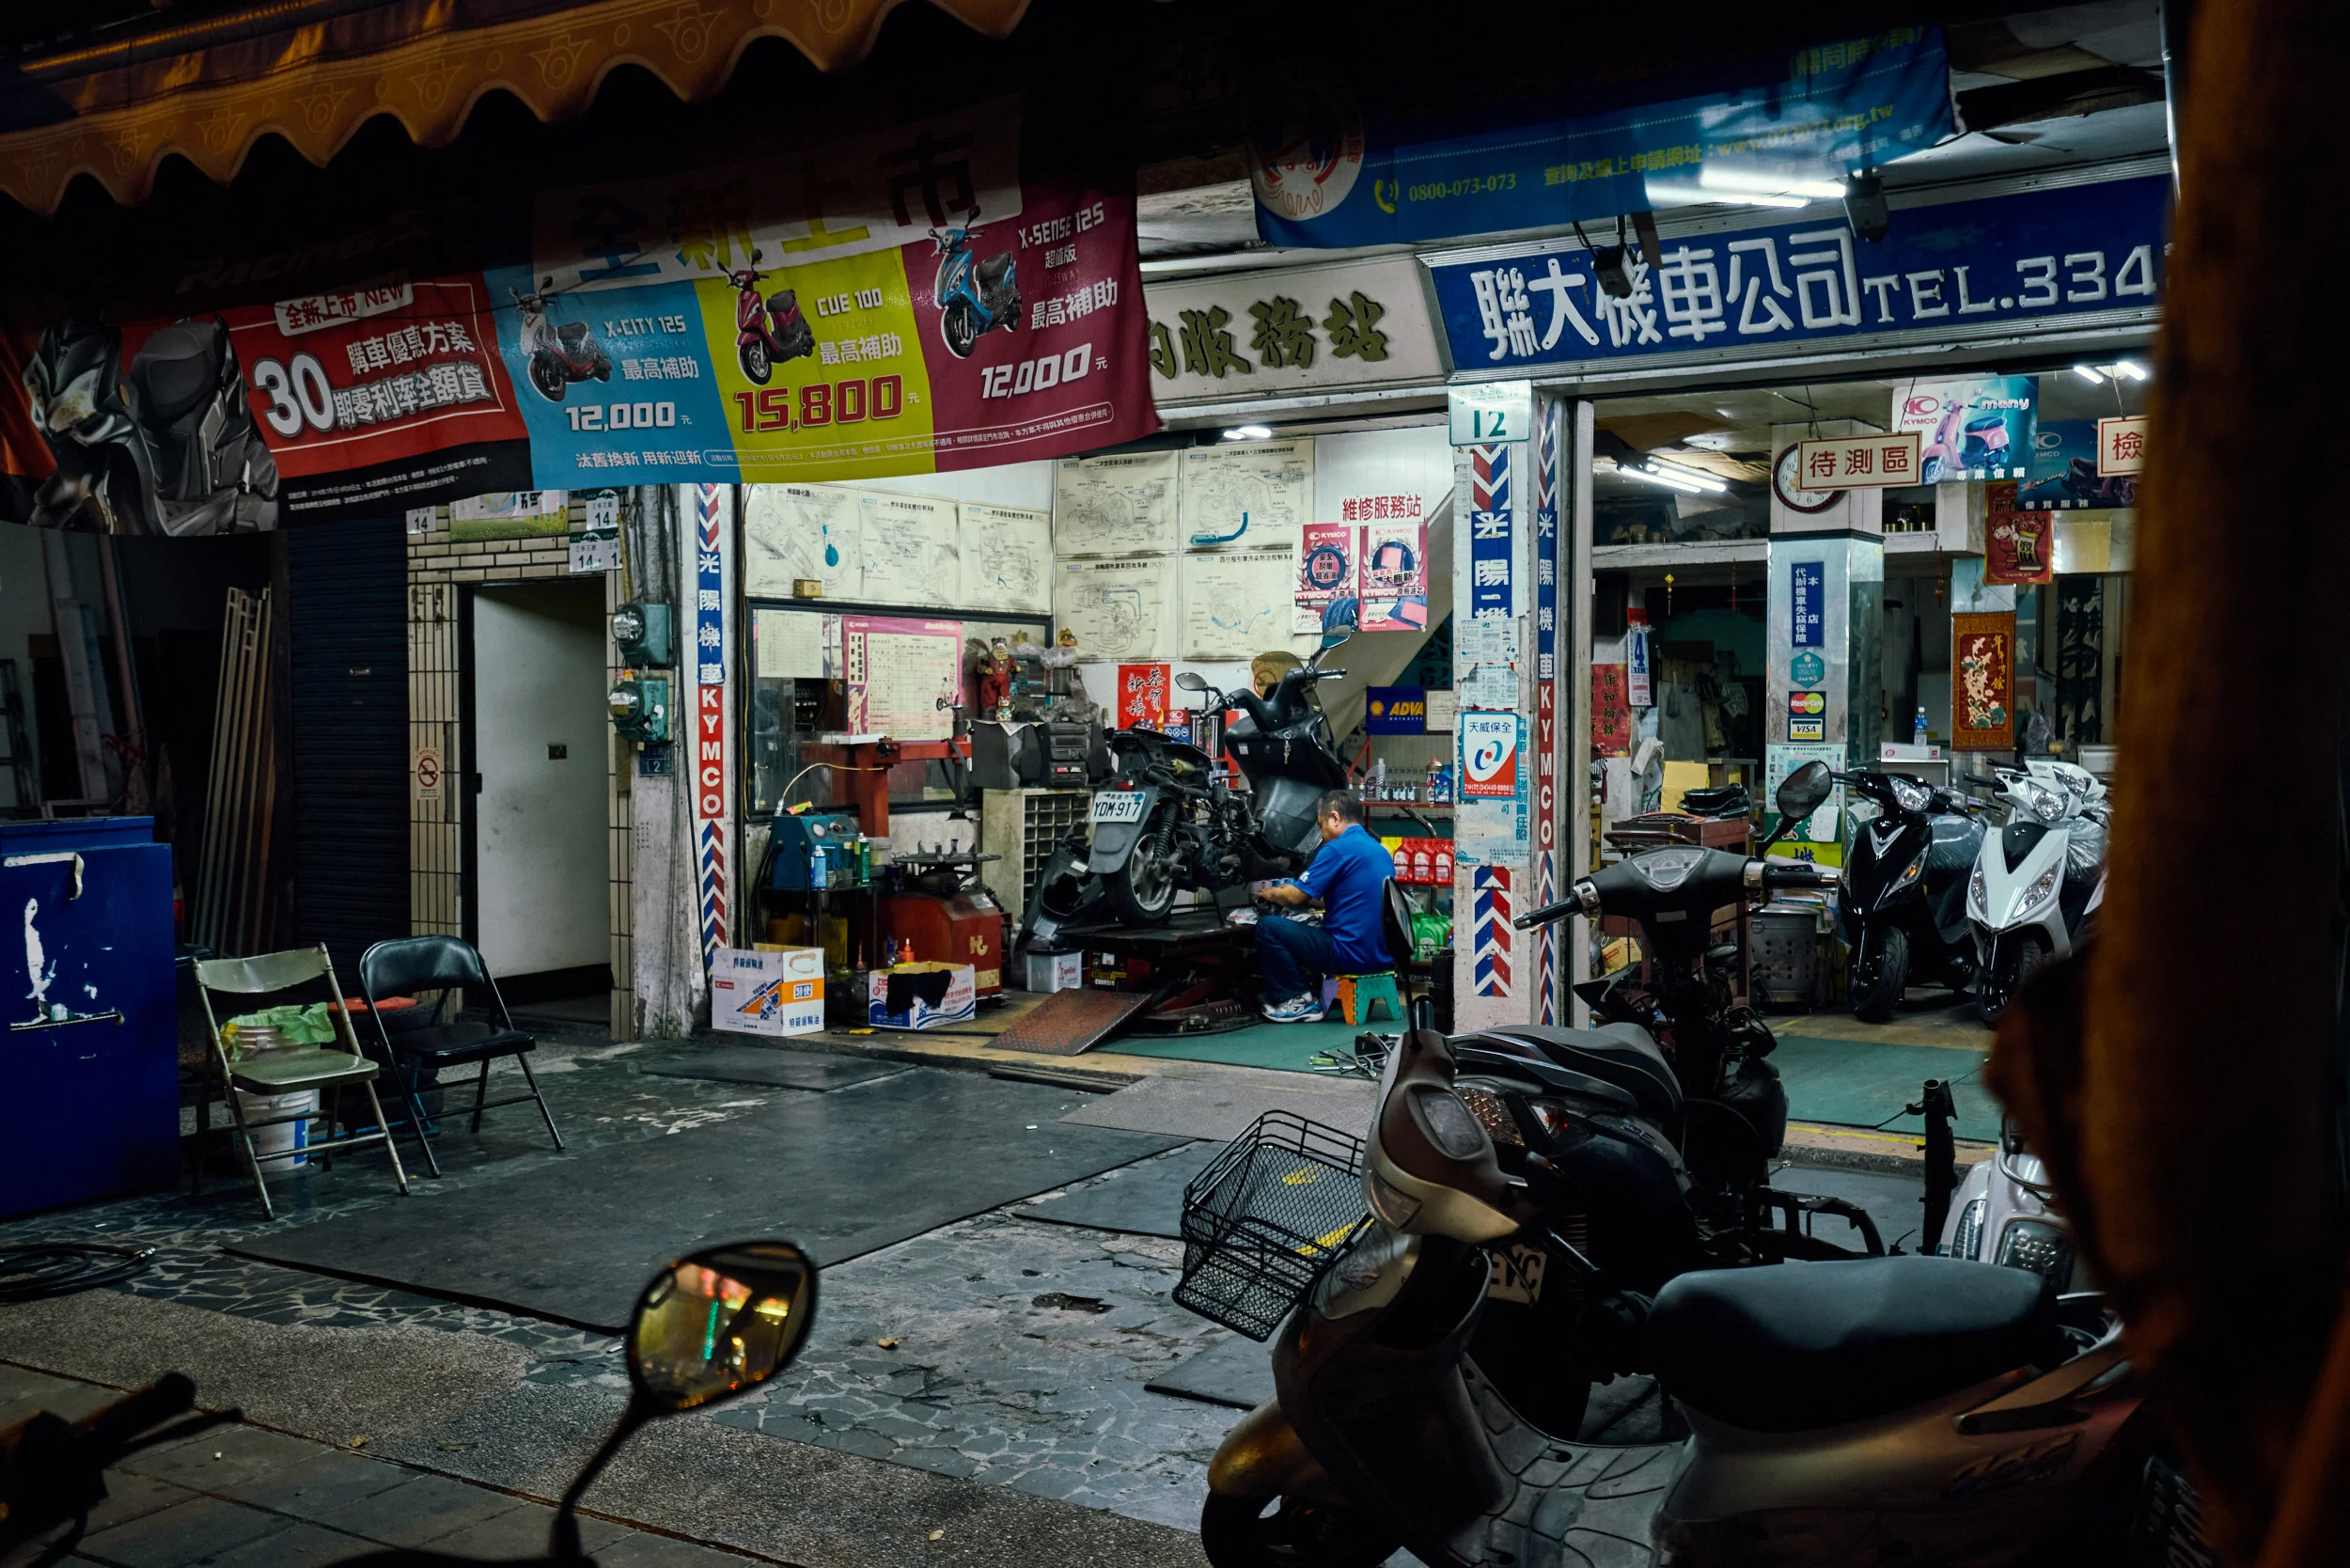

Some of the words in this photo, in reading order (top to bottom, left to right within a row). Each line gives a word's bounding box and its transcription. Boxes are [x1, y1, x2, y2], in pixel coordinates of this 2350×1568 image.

[1409, 173, 1516, 202] 0800-073-073
[1075, 201, 1105, 233] 125
[1044, 243, 1077, 270] 超值版
[286, 297, 357, 329] 全新上市
[365, 281, 406, 307] NEW
[817, 292, 850, 317] CUE
[857, 288, 883, 310] 100
[1030, 276, 1119, 330] 最高補助
[603, 318, 655, 337] X-CITY
[659, 315, 686, 334] 125
[347, 321, 475, 374] 購車優惠方案
[819, 332, 902, 367] 最高補助
[621, 356, 699, 381] 最高補助
[980, 342, 1092, 400] 12,000
[1095, 356, 1108, 371] 元
[253, 352, 334, 437] 30
[734, 374, 903, 433] 15,800
[908, 392, 920, 404] 元
[1982, 398, 2029, 410] many
[566, 401, 675, 432] 12,000
[681, 415, 693, 426] 元
[1474, 410, 1506, 438] 12
[1904, 417, 1937, 426] KYMCO
[576, 451, 640, 468] 汰舊換新
[644, 449, 702, 466] 用新迎新
[1810, 446, 1909, 478] 待測區
[596, 511, 610, 526] 14
[1342, 494, 1421, 521] 維修服務站
[2026, 499, 2089, 510] 優質服務
[415, 517, 428, 529] 14
[579, 556, 593, 569] 14
[1320, 553, 1333, 561] 安全
[1295, 591, 1329, 600] KYMCO
[1362, 588, 1397, 597] KYMCO
[1539, 513, 1554, 680] 光陽機車
[1795, 568, 1807, 643] 代辦機車失竊保險
[1808, 576, 1819, 624] 本店
[698, 554, 725, 685] 光陽機車
[1635, 634, 1644, 666] 4
[1469, 722, 1512, 733] 天威保全
[702, 688, 721, 815] KYMCO
[1541, 685, 1553, 843] KYMCO
